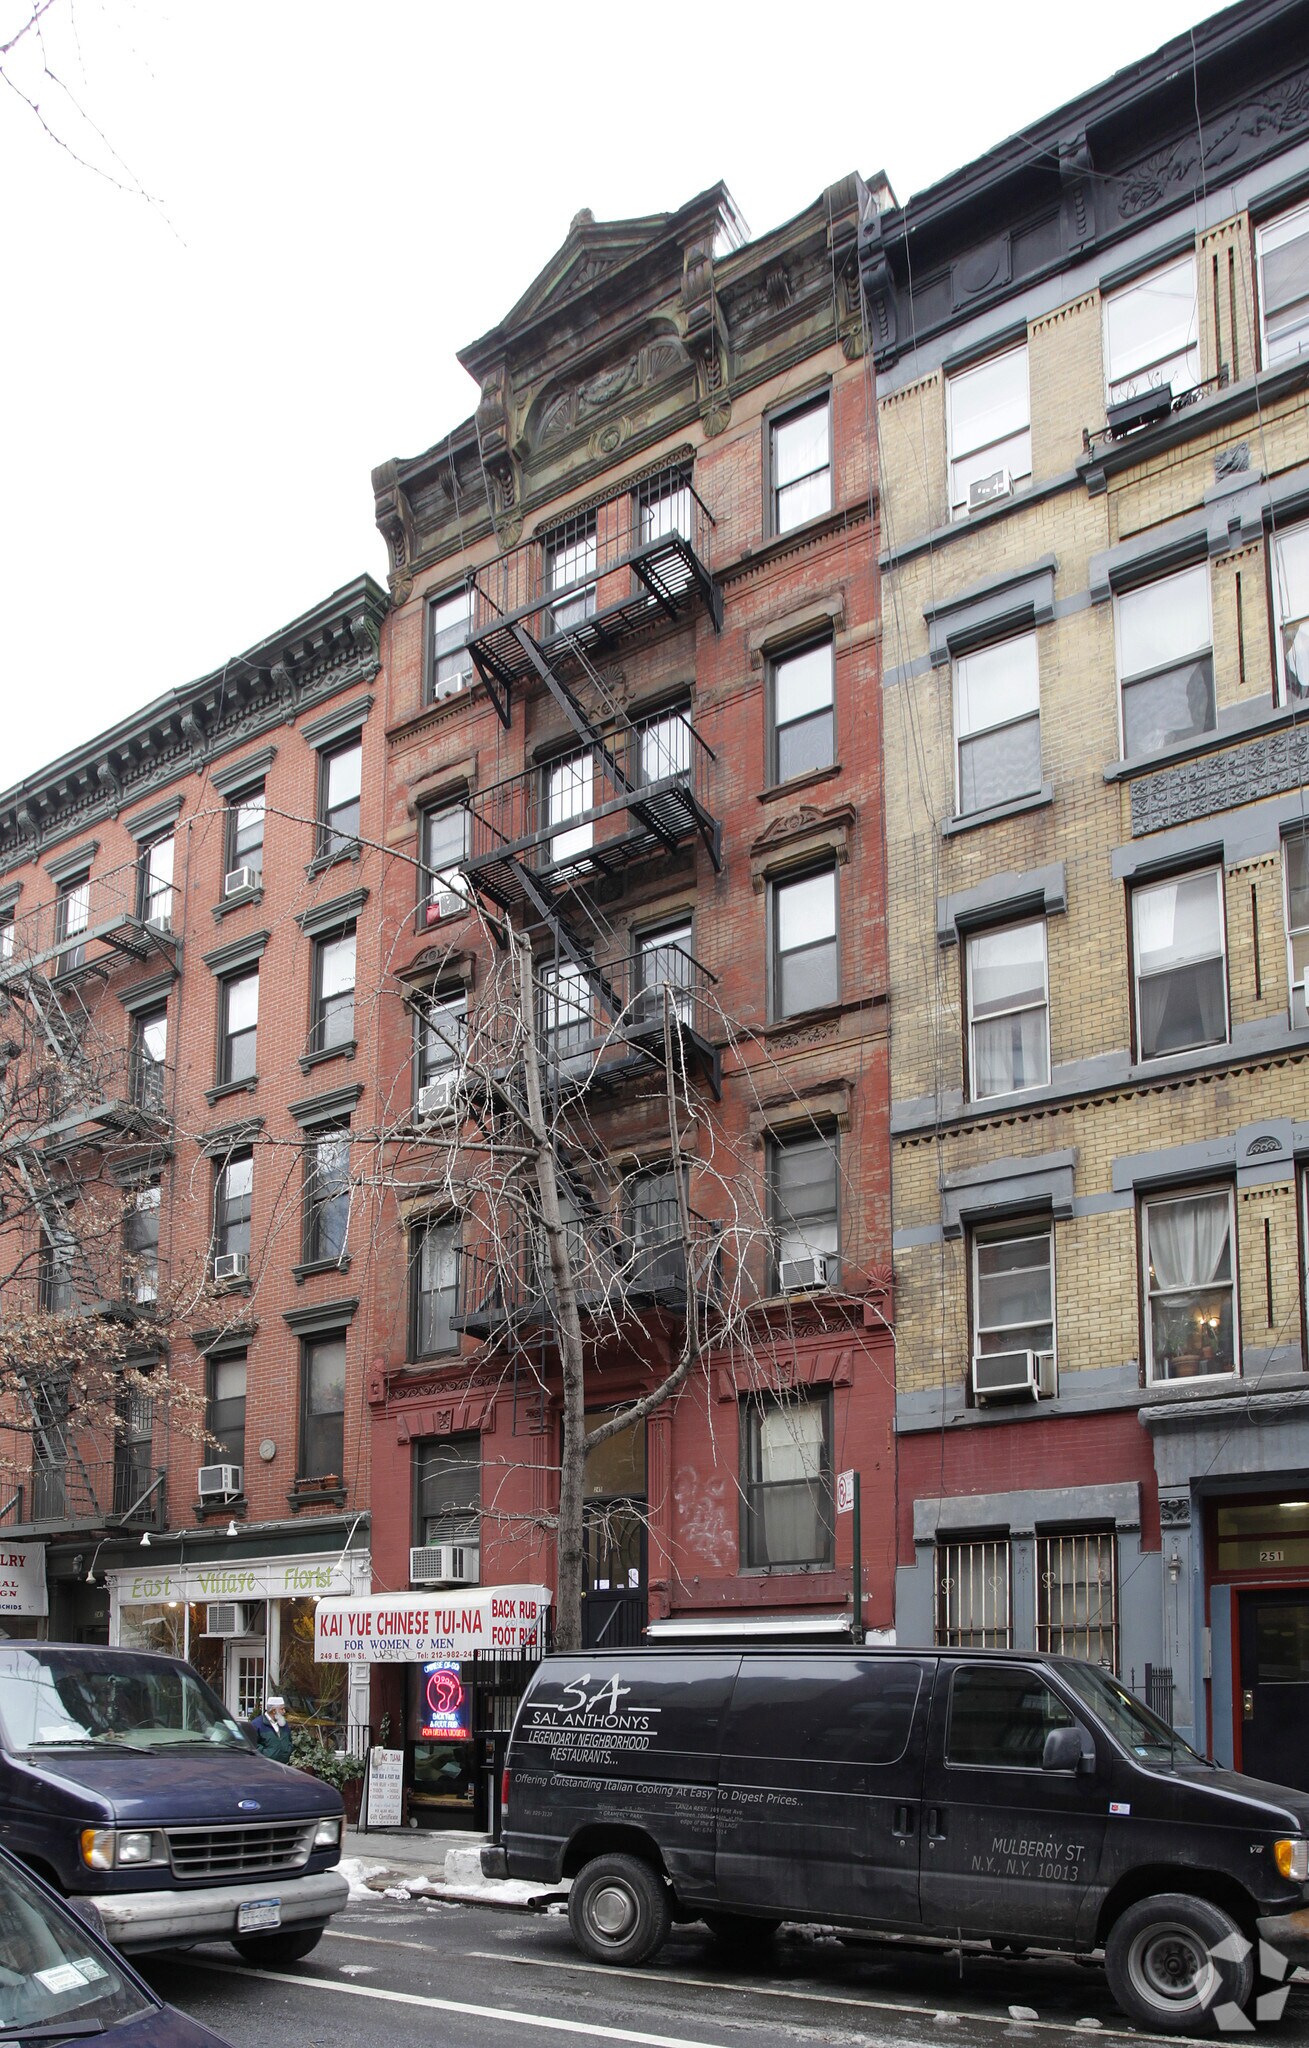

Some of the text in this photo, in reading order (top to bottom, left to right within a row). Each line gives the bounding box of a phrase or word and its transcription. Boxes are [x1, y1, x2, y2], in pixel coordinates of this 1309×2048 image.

[1261, 1551, 1281, 1561] 251
[132, 1566, 334, 1598] East Village Florist
[492, 1599, 537, 1619] BACK RUB
[320, 1609, 483, 1637] KAI YUE CHINESE TUI-NA
[344, 1638, 455, 1650] FOR WOMEN & MEN
[492, 1627, 537, 1646] FOOT RUB
[417, 1651, 429, 1659] Tel:
[557, 1672, 632, 1714] SA
[532, 1712, 650, 1731] SAL ANTHONYS
[528, 1730, 650, 1750] LEGENDARY NEIGHBORHOOD
[550, 1747, 619, 1765] RESTAURANTS...
[515, 1773, 548, 1787] Offering
[550, 1776, 602, 1791] Outstanding
[604, 1780, 633, 1792] Italian
[636, 1783, 674, 1798] Cooking
[676, 1786, 687, 1797] At
[690, 1787, 713, 1800] Easy
[716, 1789, 728, 1800] To
[731, 1790, 764, 1803] Digest
[991, 1837, 1086, 1862] MULBERRY ST.
[971, 1855, 1079, 1882] N.Y., N.Y. 10013
